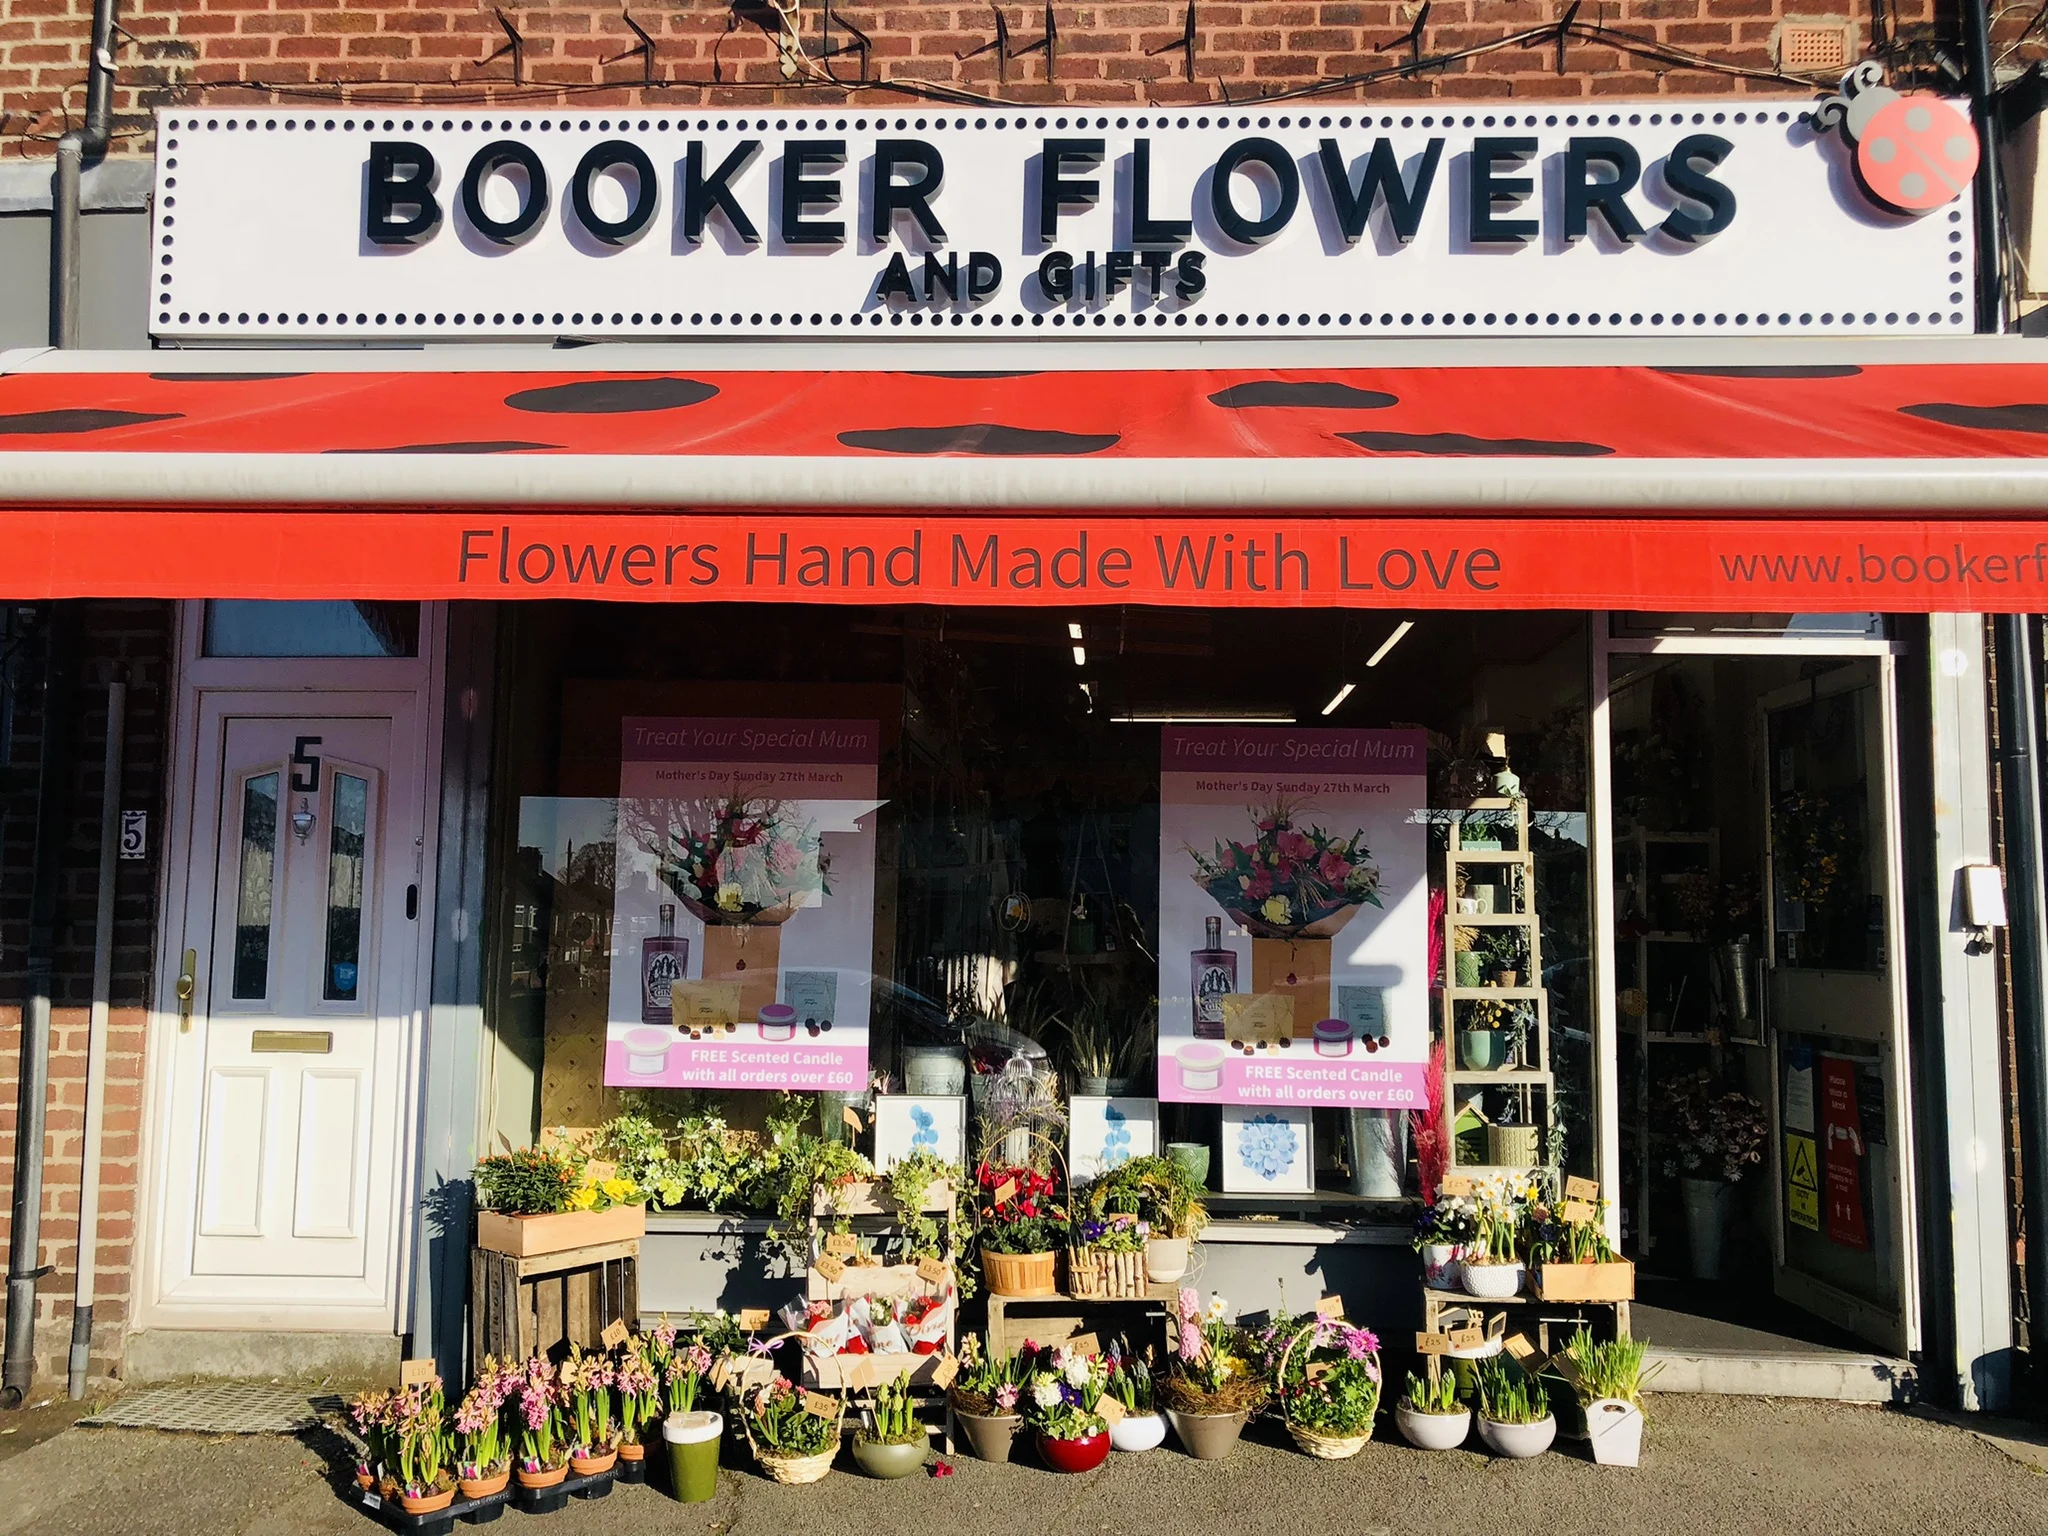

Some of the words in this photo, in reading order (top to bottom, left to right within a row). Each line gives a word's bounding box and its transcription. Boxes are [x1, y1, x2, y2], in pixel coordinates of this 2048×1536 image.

[366, 139, 948, 246] BOOKER
[1041, 134, 1737, 245] FLOWERS
[876, 251, 1003, 302] AND
[1038, 250, 1208, 302] GIFTS
[458, 526, 719, 587] Flowers
[744, 529, 922, 587] Hand
[951, 530, 1132, 589] Made
[1153, 532, 1309, 591] With
[1339, 536, 1501, 592] Love
[1719, 543, 2048, 584] www.bookerf
[634, 727, 688, 747] Treat
[693, 728, 737, 748] Your
[741, 728, 814, 752] Special
[819, 730, 868, 749] Mum
[1174, 737, 1228, 757] Treat
[1232, 738, 1279, 758] Your
[1282, 738, 1358, 763] Special
[1363, 740, 1416, 759] Mum
[292, 736, 323, 792] 5
[655, 769, 707, 782] Mother's
[709, 771, 730, 783] Day
[733, 770, 776, 784] Sunday
[779, 771, 805, 783] 27th
[808, 772, 843, 783] March
[1196, 779, 1249, 792] Mother's
[1251, 781, 1273, 795] Day
[1276, 781, 1320, 795] Sunday
[1323, 782, 1350, 793] 27th
[1353, 782, 1390, 794] March
[123, 817, 143, 851] 5
[691, 1049, 727, 1063] FREE
[731, 1050, 789, 1065] Scented
[793, 1052, 843, 1066] Candle
[682, 1068, 715, 1082] with
[718, 1069, 737, 1083] all
[741, 1070, 788, 1084] orders
[791, 1072, 824, 1085] over
[827, 1071, 853, 1086] £60
[1245, 1065, 1282, 1079] FREE
[1286, 1066, 1346, 1082] Scented
[1350, 1068, 1403, 1083] Candle
[1238, 1084, 1271, 1099] with
[1275, 1085, 1295, 1100] all
[1298, 1086, 1346, 1101] orders
[1349, 1088, 1384, 1102] over
[1387, 1088, 1414, 1103] £60
[609, 1328, 622, 1341] £10
[1425, 1337, 1441, 1347] £25
[411, 1368, 426, 1378] £10
[813, 1401, 829, 1412] £35
